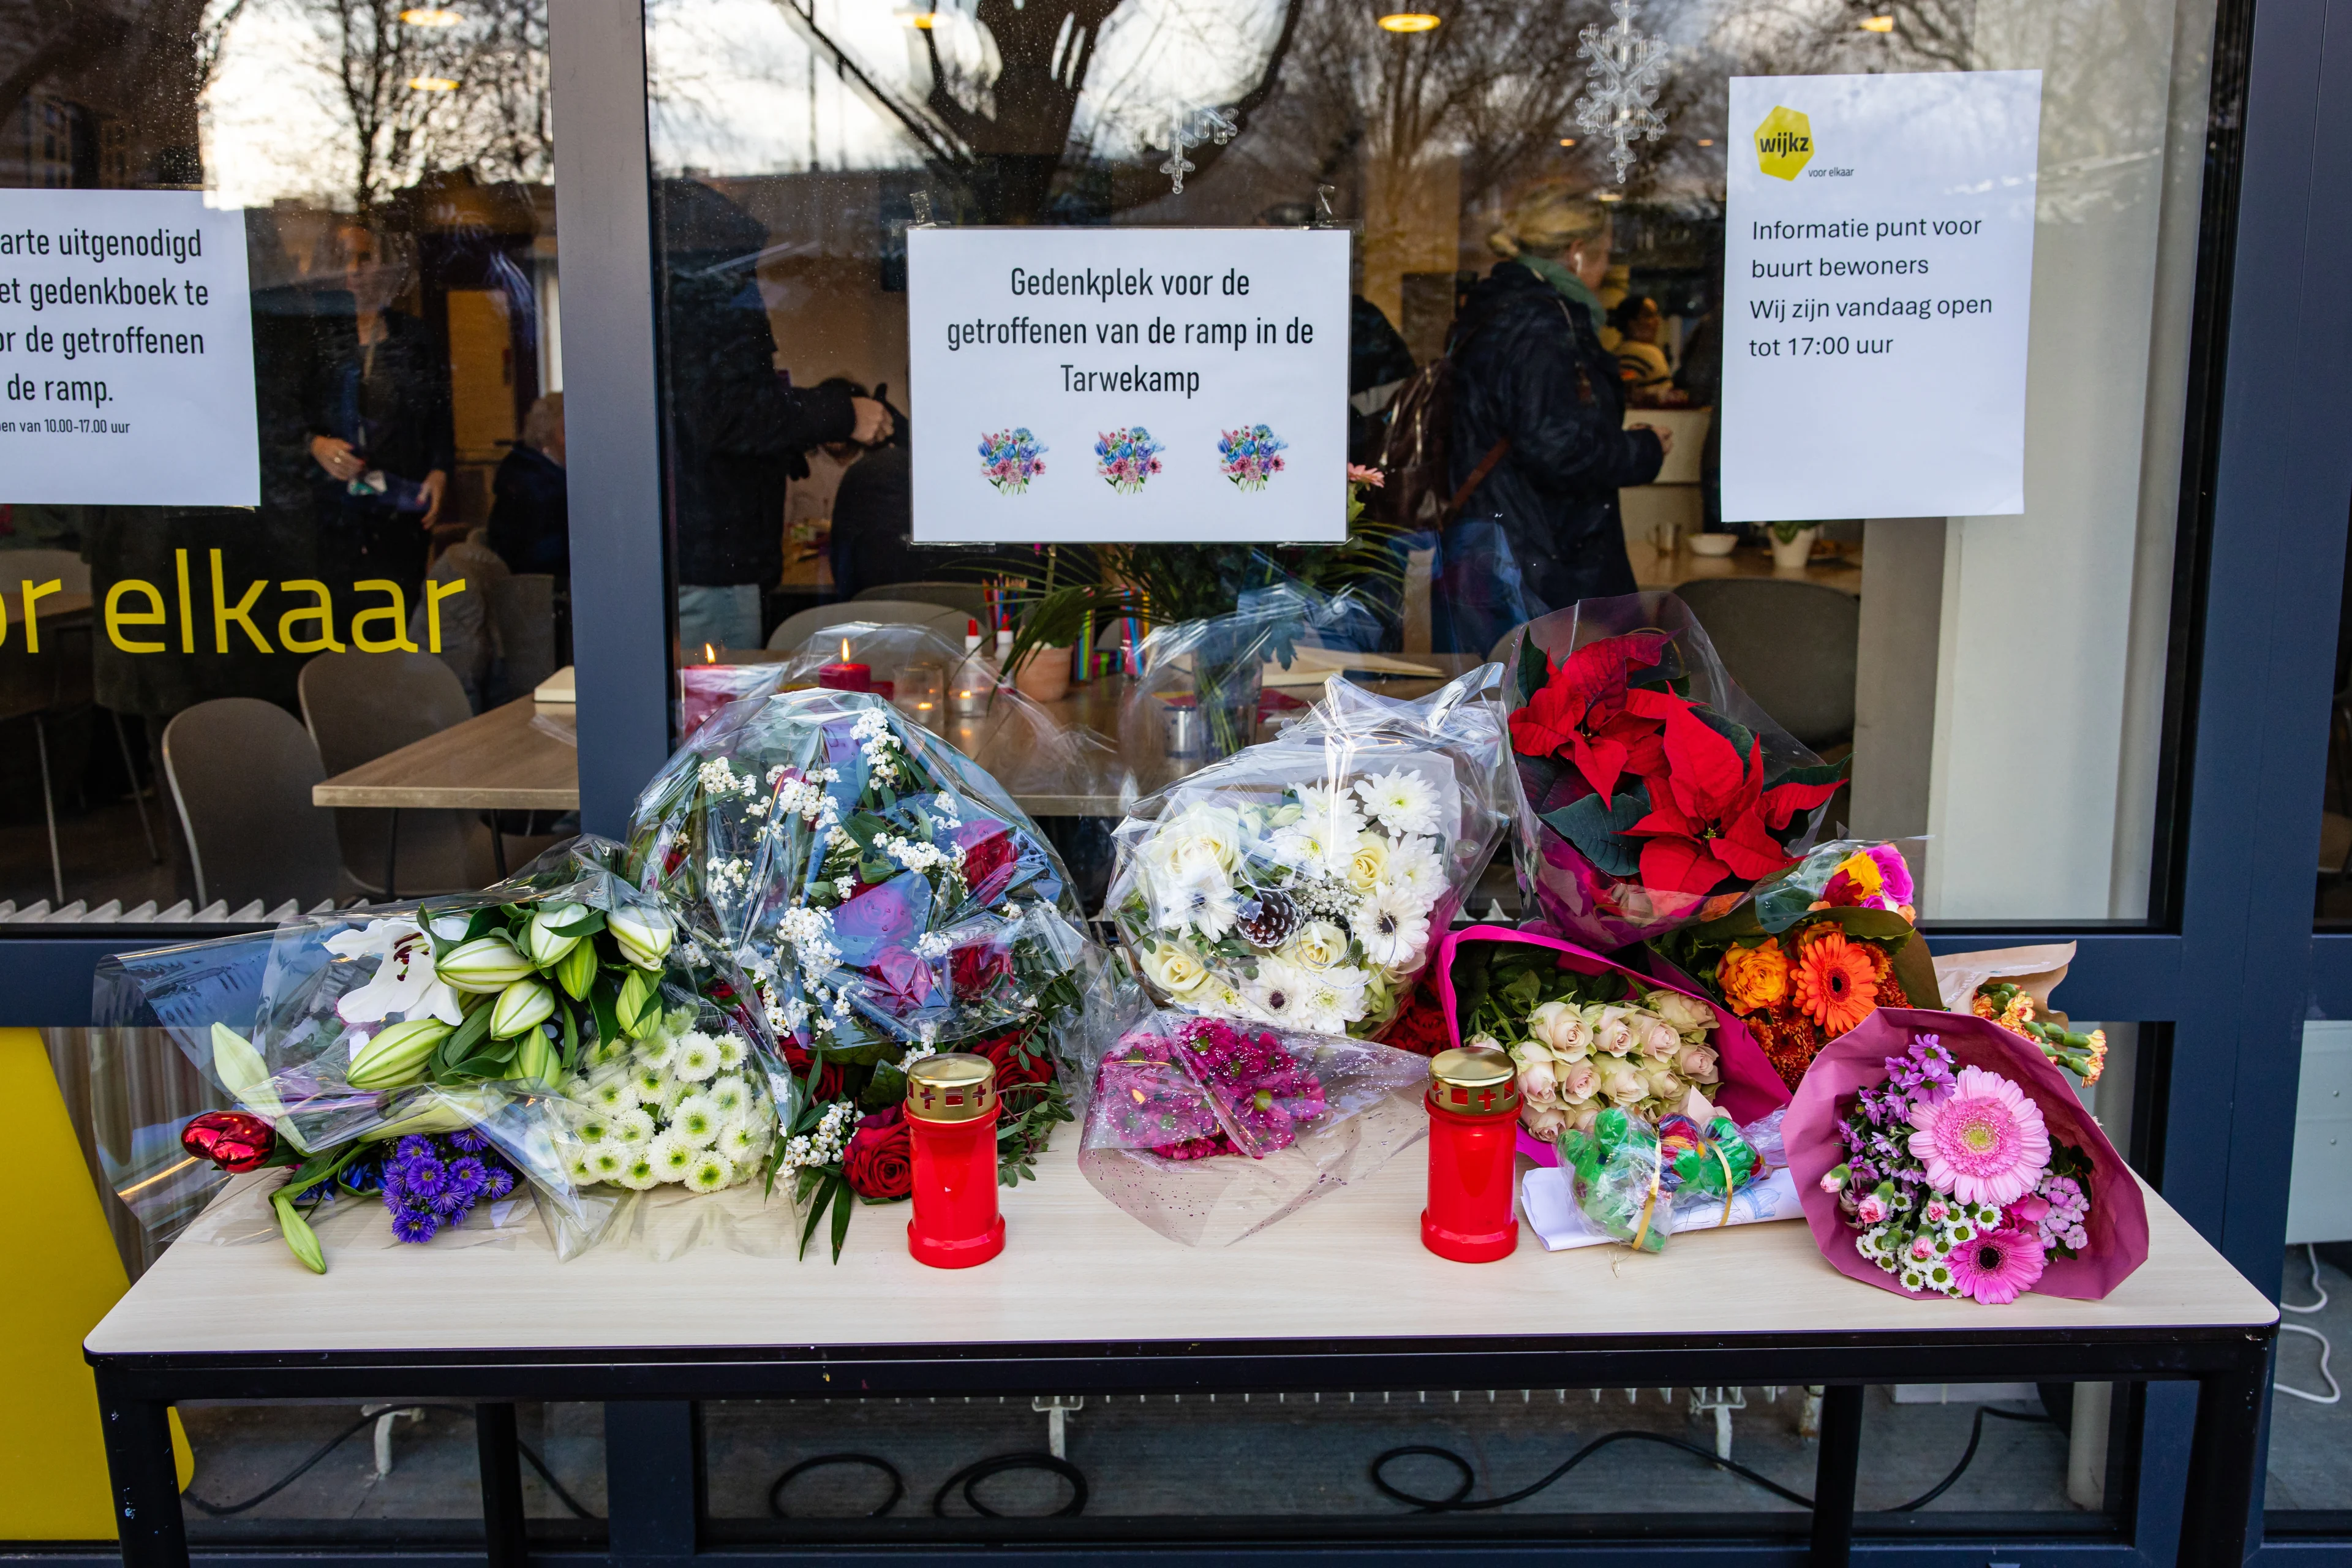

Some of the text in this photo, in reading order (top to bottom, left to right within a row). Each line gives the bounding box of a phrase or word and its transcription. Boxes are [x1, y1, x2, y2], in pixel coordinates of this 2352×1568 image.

[1760, 132, 1809, 158] wijkz
[1829, 168, 1853, 176] elkaar
[59, 228, 201, 263] uitgenodigd
[1754, 219, 1981, 241] Informatie punt voor
[1752, 258, 1928, 277] buurt bewoners
[30, 277, 178, 311] gedenkboek
[184, 281, 208, 306] te
[1012, 268, 1249, 303] Gedenkplek voor de
[1750, 298, 1991, 323] Wij zijn vandaag open
[26, 325, 53, 352] de
[63, 326, 203, 360] getroffenen
[948, 317, 1313, 351] getroffenen van de ramp in de
[1749, 337, 1893, 356] tot 17:00 uur
[7, 373, 113, 409] de ramp.
[1061, 365, 1199, 399] Tarwekamp
[0, 420, 130, 433] en van 10.00-17.00 uur
[0, 549, 465, 652] r elkaar
